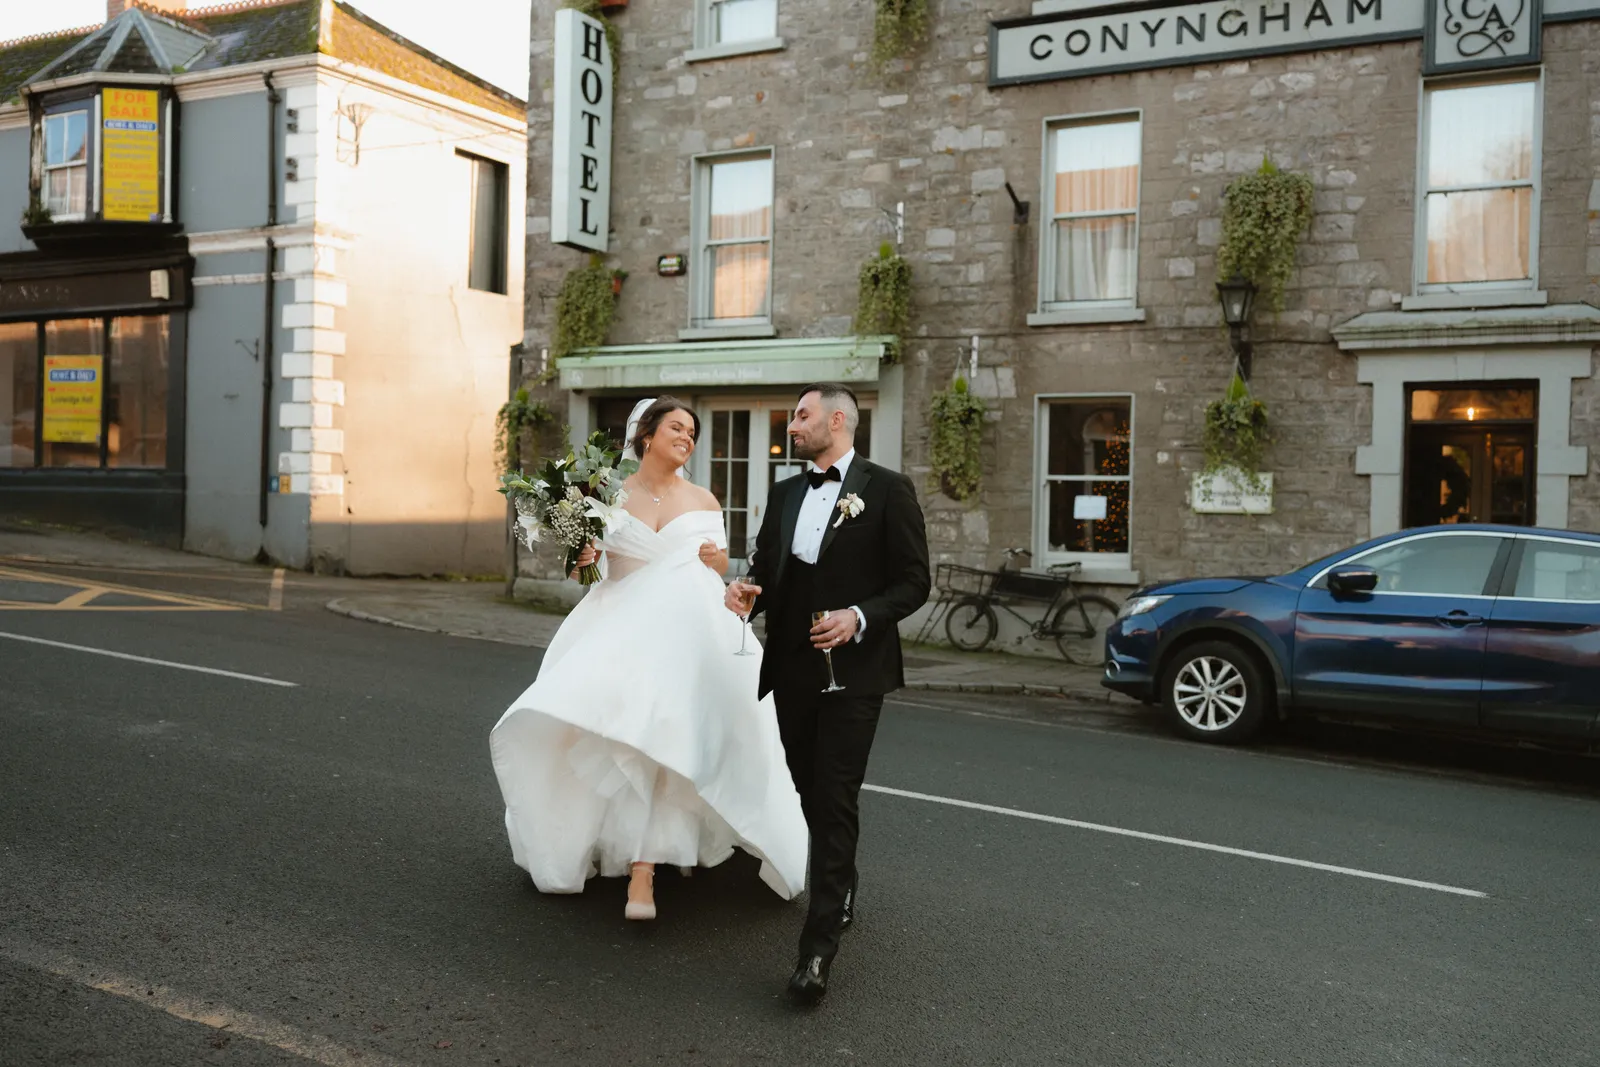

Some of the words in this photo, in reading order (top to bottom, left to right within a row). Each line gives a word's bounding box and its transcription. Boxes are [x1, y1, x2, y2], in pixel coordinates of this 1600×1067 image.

[1029, 0, 1382, 60] CONYNGHAM
[109, 105, 153, 118] SALE
[113, 91, 147, 104] FOR
[580, 20, 604, 237] HOTEL
